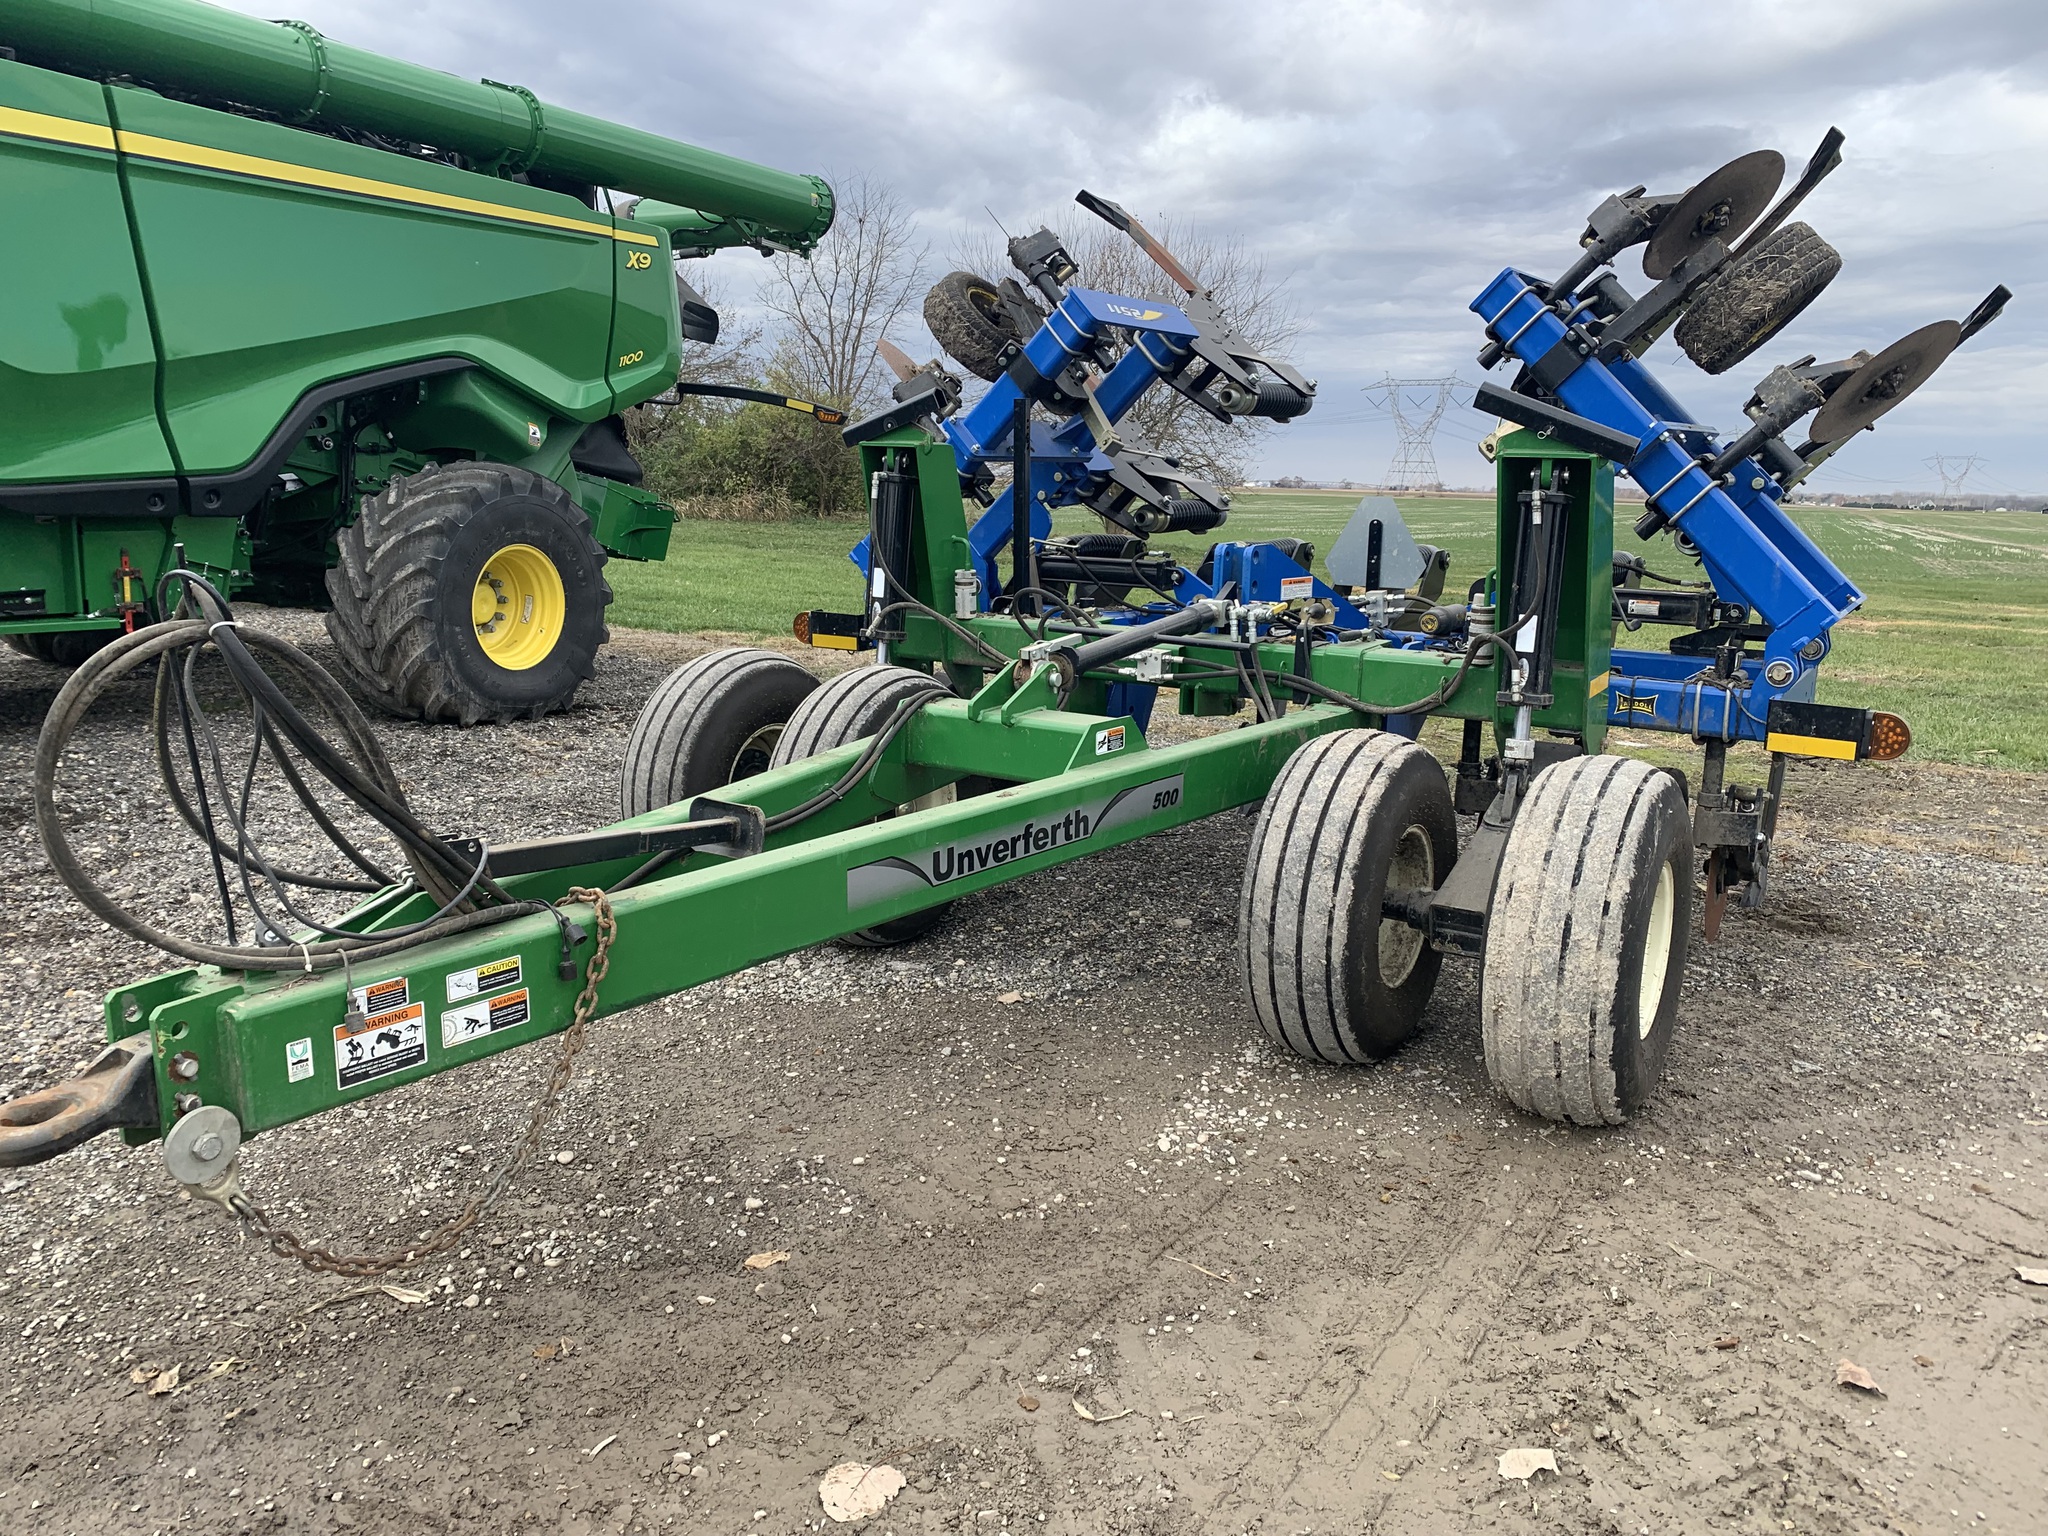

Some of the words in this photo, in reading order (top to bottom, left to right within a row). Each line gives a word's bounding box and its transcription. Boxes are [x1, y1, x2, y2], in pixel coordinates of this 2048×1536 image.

[626, 250, 652, 270] X9
[1106, 303, 1142, 319] 2511
[619, 350, 644, 367] 1100
[1620, 697, 1653, 712] LADOLL
[1152, 787, 1179, 811] 500
[932, 809, 1090, 883] Unverferth
[486, 959, 518, 974] CAUTION
[375, 980, 404, 994] WARNING
[498, 993, 526, 1005] WARNING
[291, 1063, 310, 1071] FEMA
